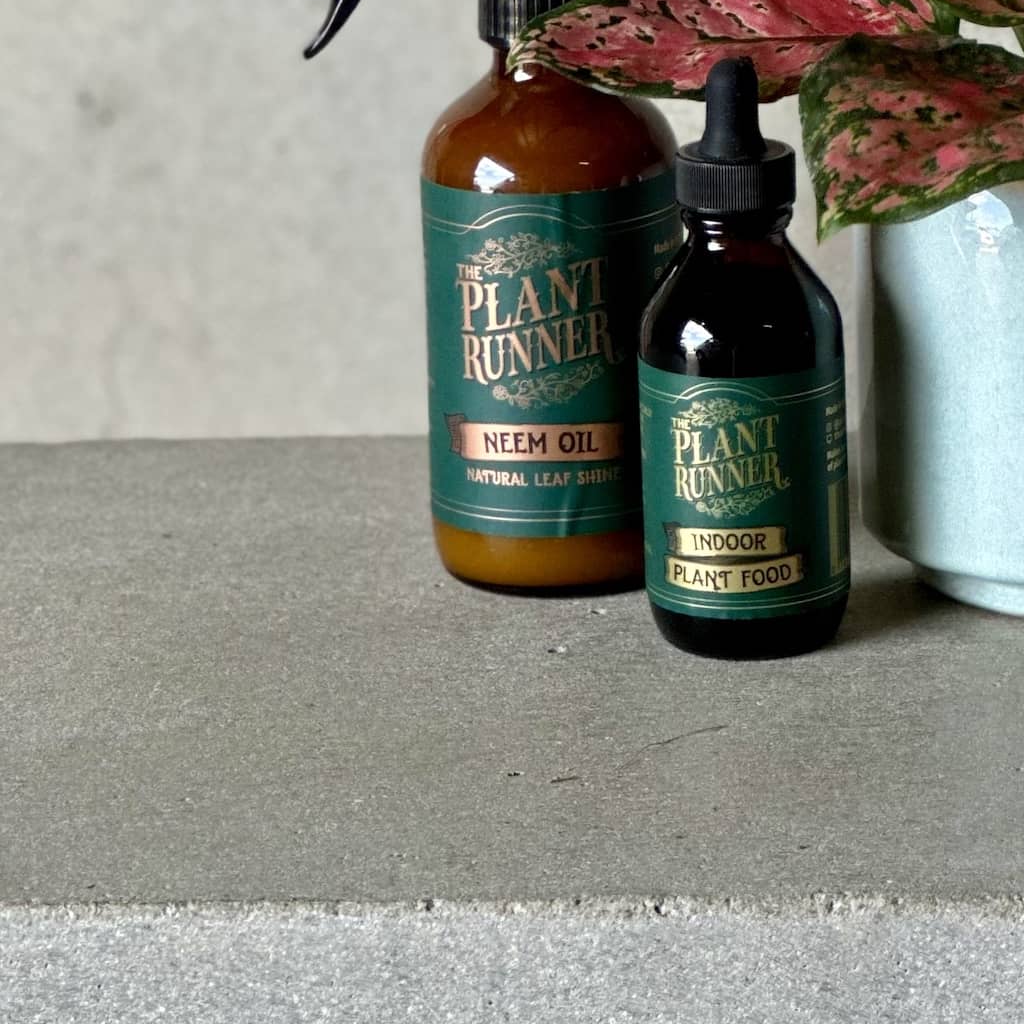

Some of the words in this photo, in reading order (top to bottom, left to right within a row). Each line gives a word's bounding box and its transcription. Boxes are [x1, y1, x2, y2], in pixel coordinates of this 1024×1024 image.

[457, 263, 483, 280] THE
[456, 257, 607, 332] PLANT
[461, 309, 625, 385] RUNNER
[672, 418, 690, 430] THE
[483, 432, 547, 454] NEEM
[558, 431, 599, 453] OIL
[671, 414, 780, 466] PLANT
[466, 467, 529, 487] NATURAL
[534, 471, 571, 487] LEAF
[577, 466, 624, 486] SHINE
[674, 451, 792, 502] RUNNER
[692, 532, 767, 552] INDOOR
[673, 563, 734, 591] PLANT
[741, 563, 793, 588] FOOD
